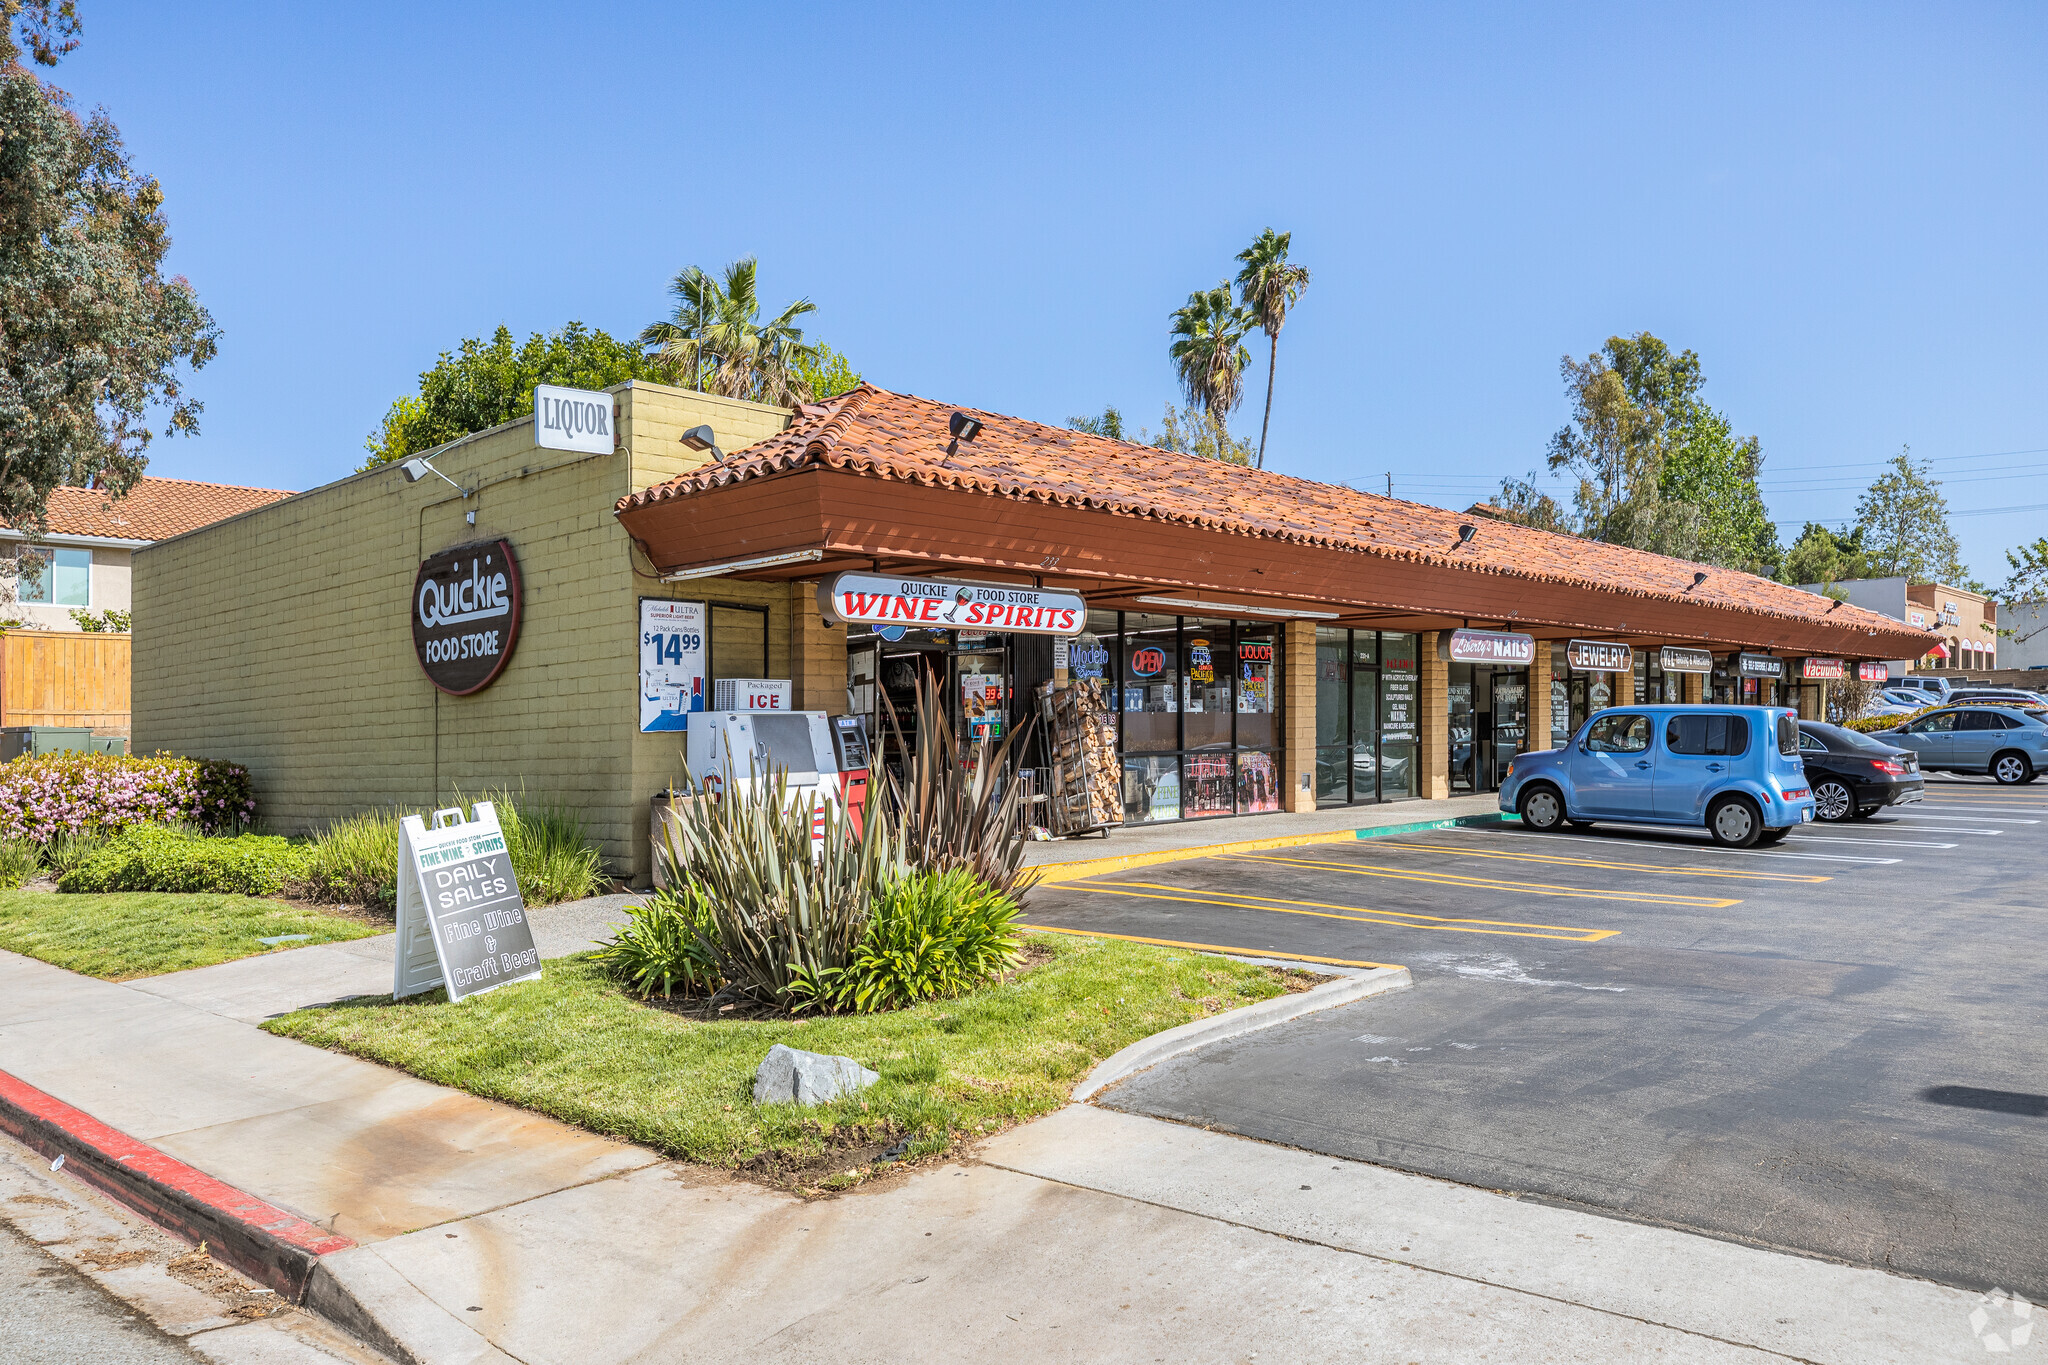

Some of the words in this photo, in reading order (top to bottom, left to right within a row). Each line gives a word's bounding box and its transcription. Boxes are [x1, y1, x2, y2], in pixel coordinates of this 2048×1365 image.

[543, 396, 609, 439] LIQUOR
[1040, 556, 1060, 567] 233
[419, 554, 509, 628] Quickie
[901, 582, 948, 597] QUICKIE
[977, 589, 1005, 602] FOOD
[1008, 591, 1039, 604] STORE
[675, 606, 699, 615] ULTRA
[843, 591, 943, 621] WINE
[965, 602, 1077, 630] SPIRITS
[660, 625, 671, 633] Pack
[426, 638, 459, 664] FOOD
[460, 629, 499, 660] STORE
[1070, 644, 1109, 667] Modelo
[1239, 645, 1272, 660] LIQUOR
[1454, 635, 1491, 656] Liberty's
[1493, 639, 1529, 658] NAILS
[1575, 645, 1625, 668] JEWELRY
[1132, 649, 1163, 673] OPEN
[747, 681, 783, 689] Packaged
[749, 694, 780, 708] ICE
[1191, 758, 1227, 776] LIQUOR
[1242, 756, 1270, 769] BEER
[1157, 785, 1179, 800] FINE
[420, 851, 441, 868] FINE
[440, 846, 464, 863] WINE
[472, 837, 504, 855] SPIRITS
[439, 840, 456, 849] QUICKIE
[468, 834, 481, 842] STORE
[435, 858, 498, 888] DAILY
[438, 878, 507, 908] SALES
[443, 919, 482, 943] Fine
[484, 907, 522, 932] Wine
[485, 935, 497, 954] &
[453, 957, 498, 987] Craft
[501, 948, 537, 972] Beer
